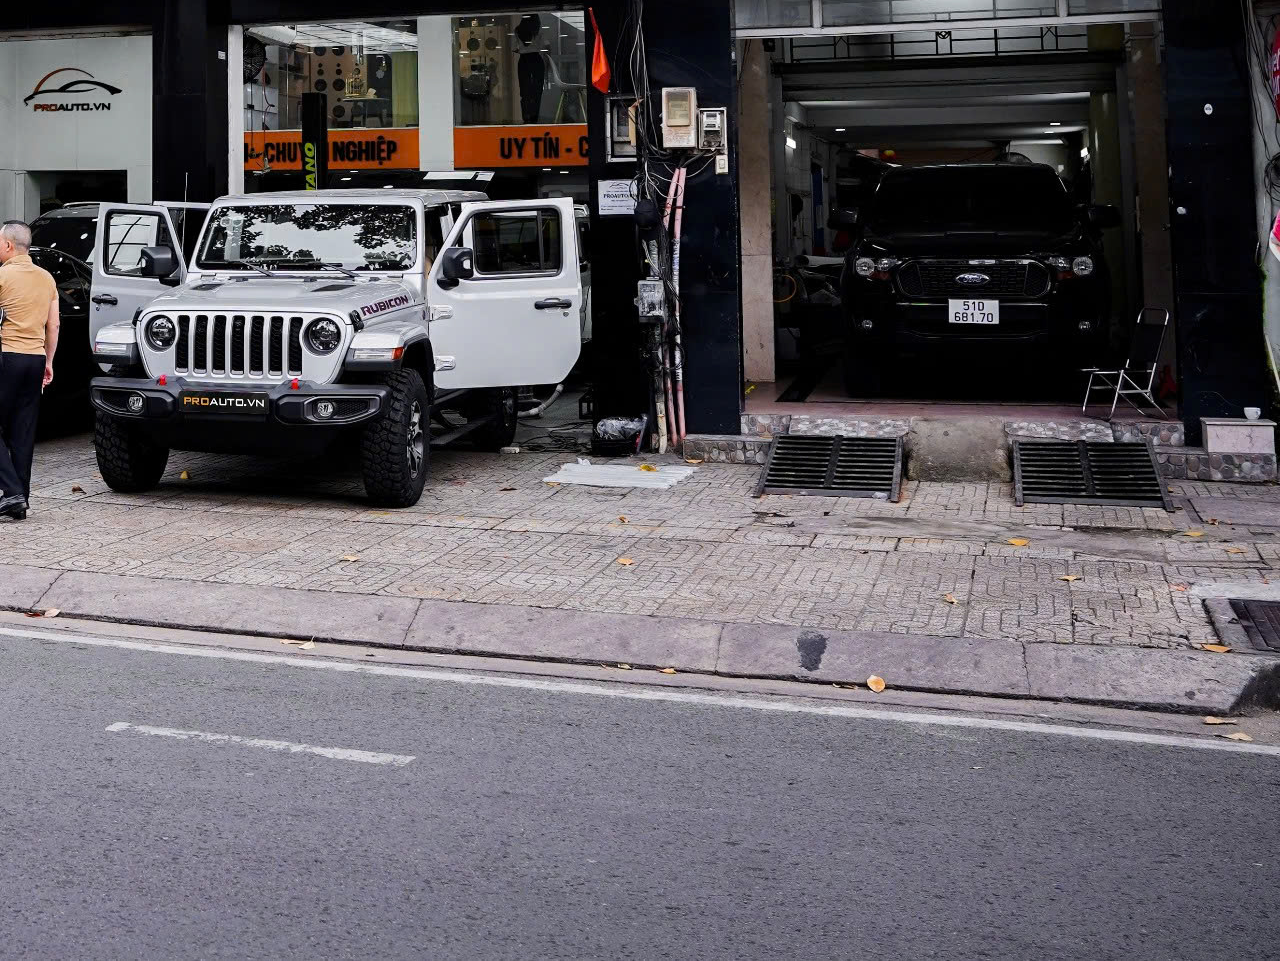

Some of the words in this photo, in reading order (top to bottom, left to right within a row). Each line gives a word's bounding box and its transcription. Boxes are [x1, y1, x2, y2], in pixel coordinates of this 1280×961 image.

[34, 102, 111, 112] PROAUTO.VN
[332, 135, 397, 166] NGHIỆP
[500, 137, 527, 159] UY
[532, 131, 559, 159] TÍN
[360, 294, 409, 316] RUBICON
[963, 300, 985, 311] 51D
[954, 311, 994, 323] 681.70
[183, 396, 265, 408] PROAUTO.VN
